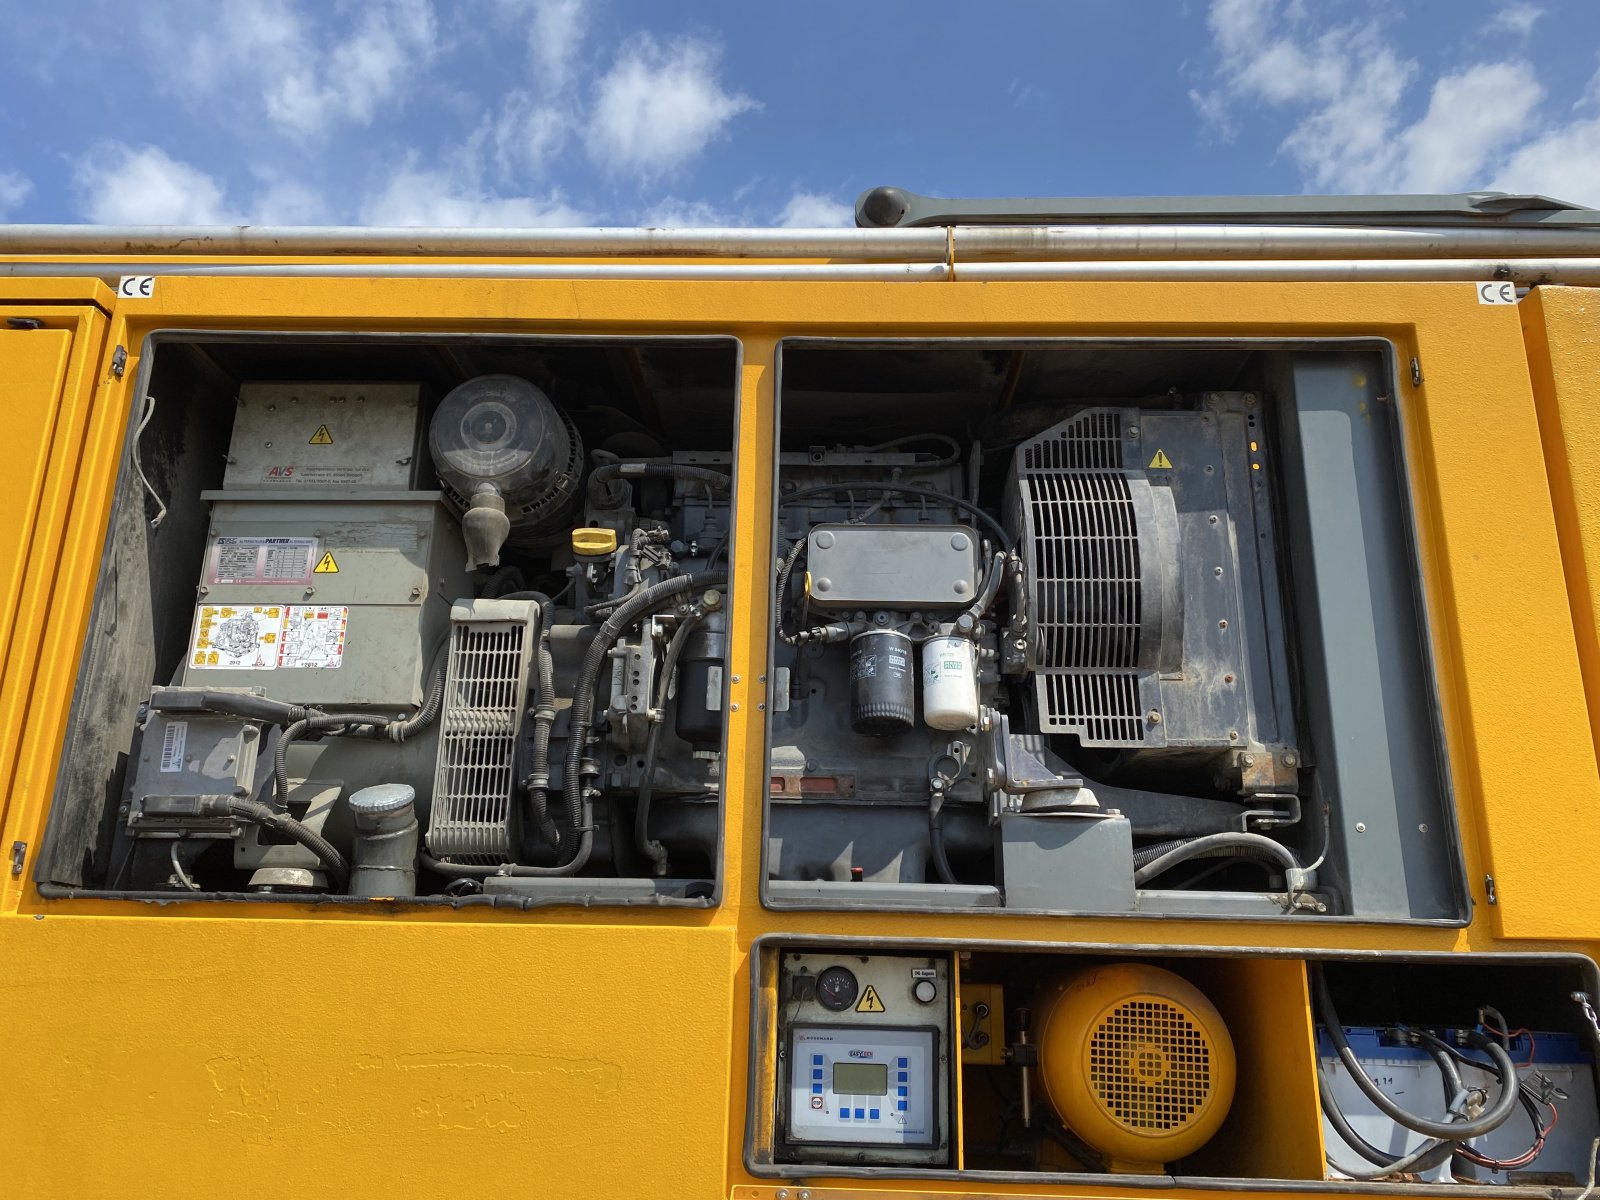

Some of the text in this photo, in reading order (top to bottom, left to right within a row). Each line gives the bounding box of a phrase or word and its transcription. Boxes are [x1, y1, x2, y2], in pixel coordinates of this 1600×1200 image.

[122, 277, 153, 296] CE
[1480, 283, 1513, 303] CE
[269, 466, 294, 476] AVS
